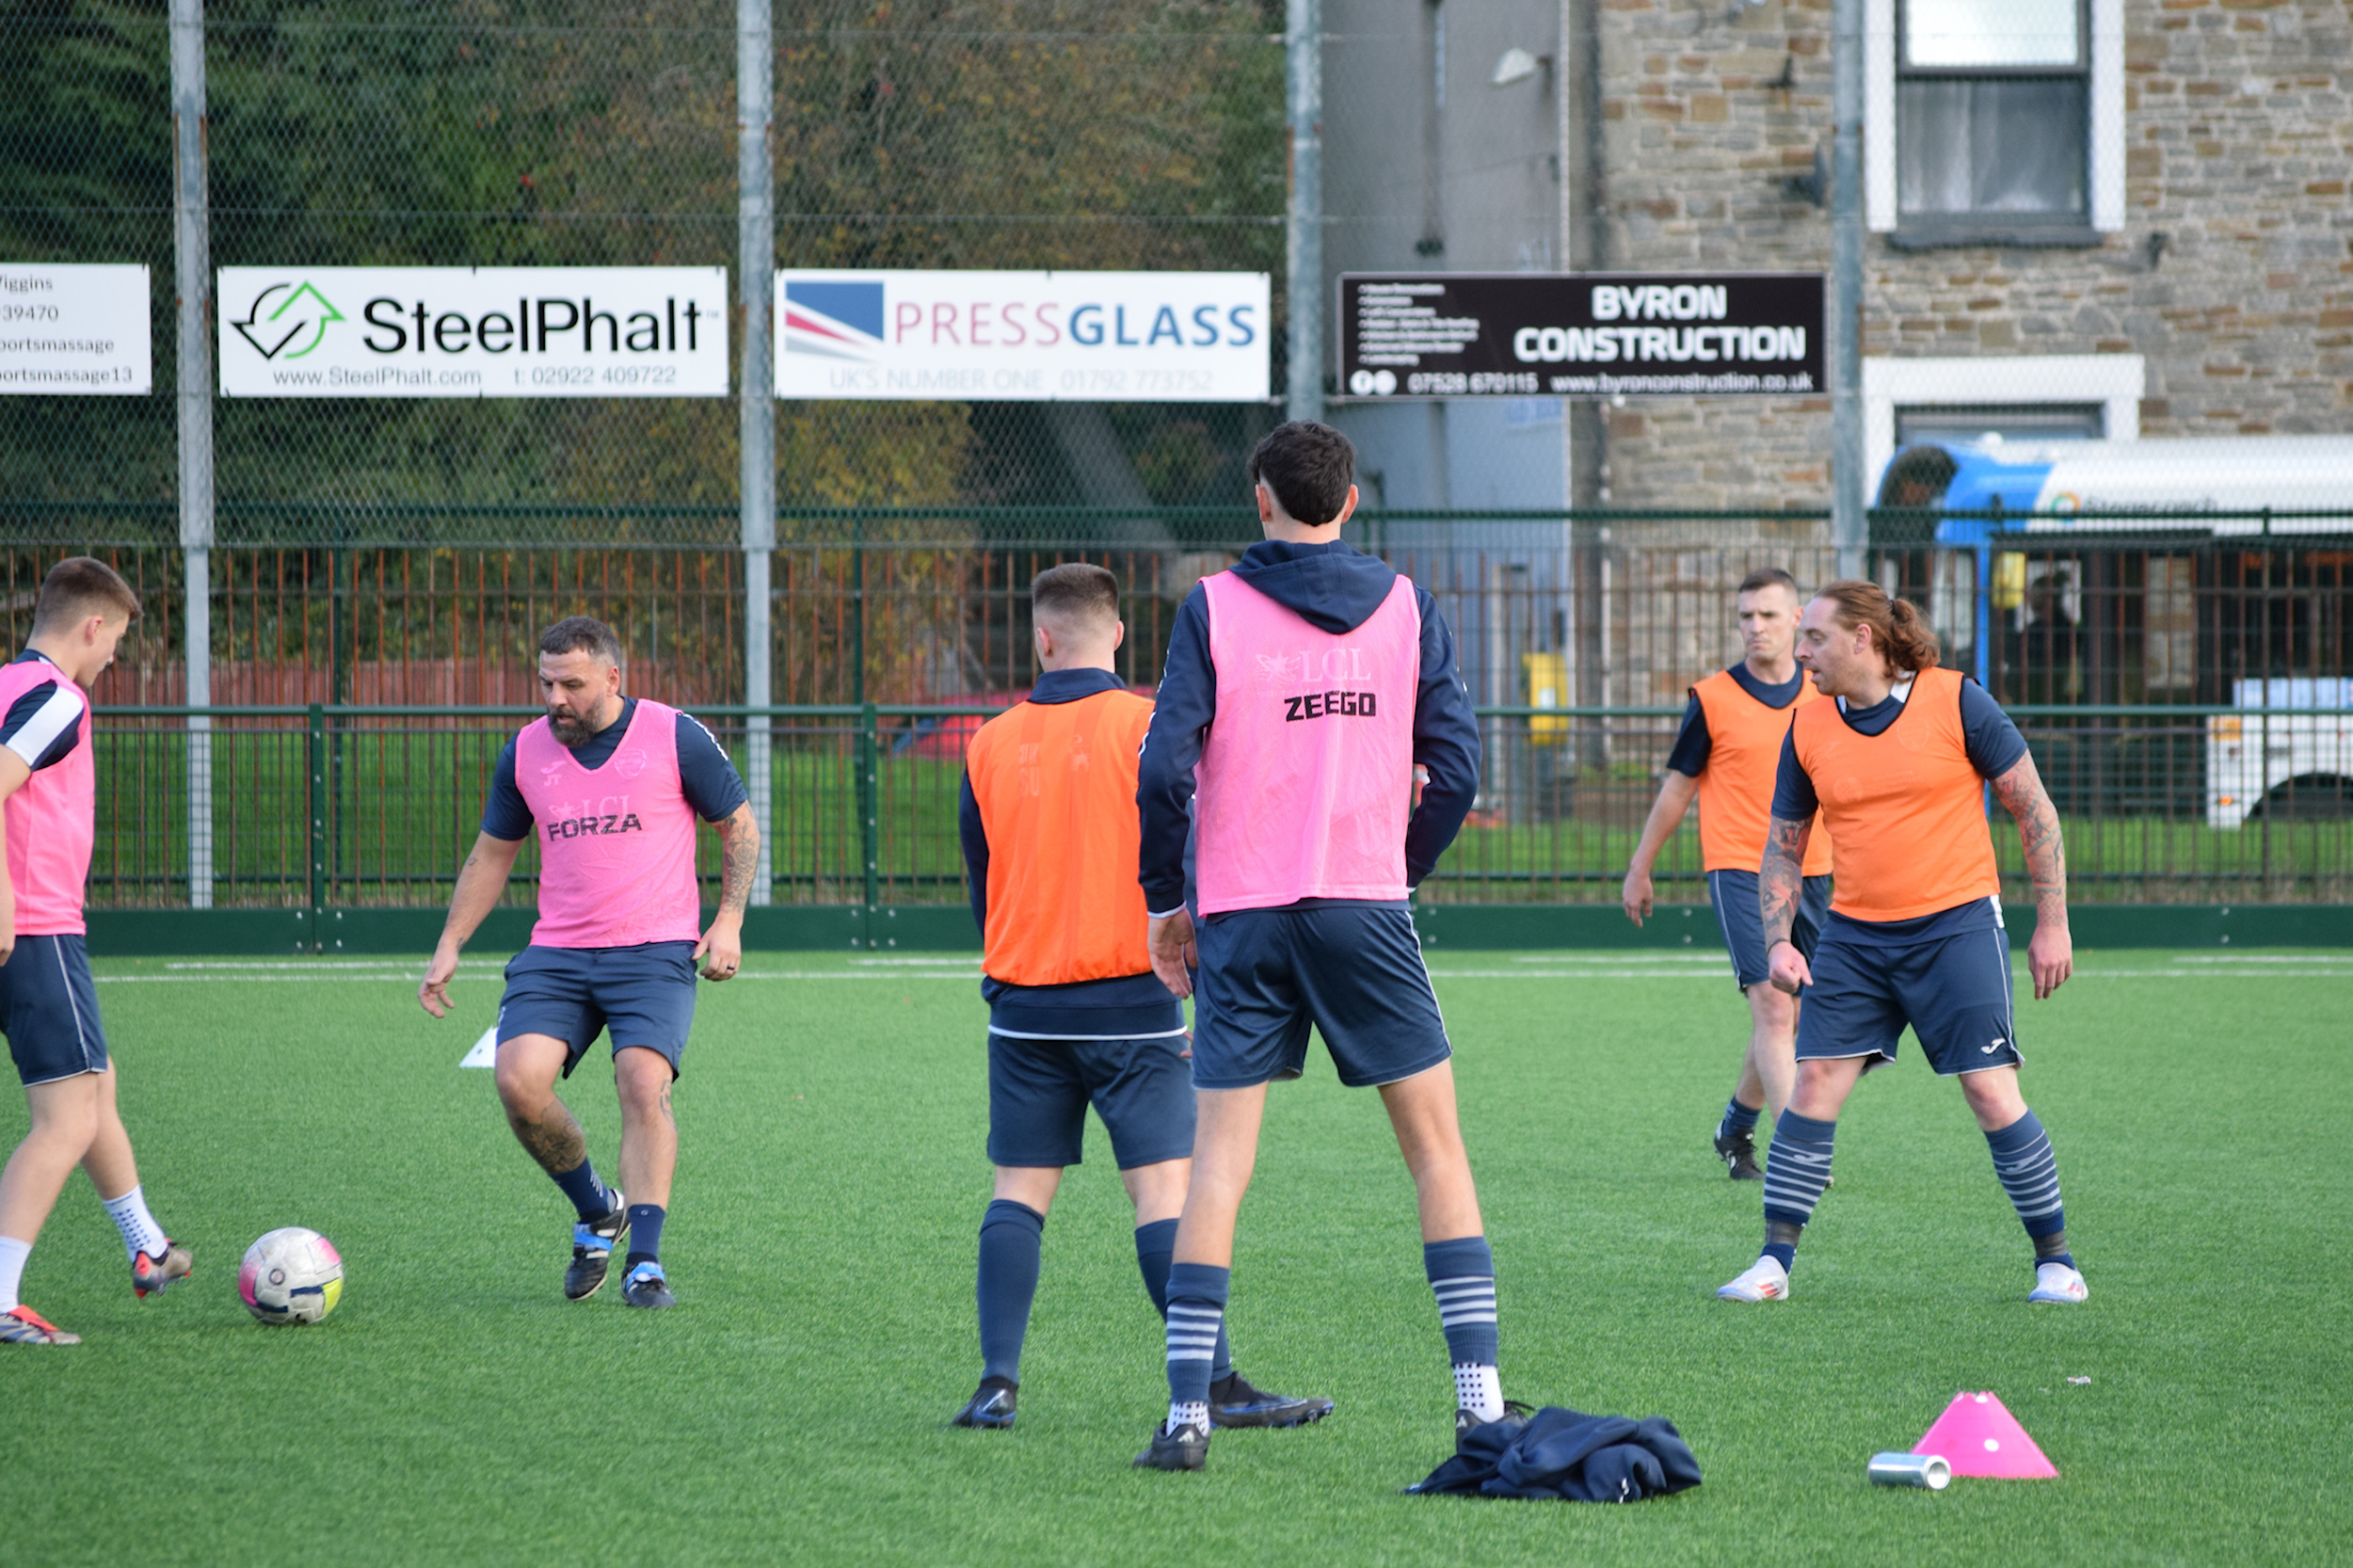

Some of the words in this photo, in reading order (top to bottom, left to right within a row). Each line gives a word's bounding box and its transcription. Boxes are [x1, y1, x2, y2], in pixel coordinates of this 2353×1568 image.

[0, 274, 53, 294] iggins
[1592, 284, 1727, 321] BYRON
[362, 296, 701, 354] SteelPhalt
[895, 301, 1256, 347] PRESSGLASS
[1513, 326, 1807, 363] CONSTRUCTION
[0, 366, 133, 387] ortsmassage13
[272, 365, 482, 387] www.SteelPhalt.com
[531, 365, 595, 386] 02922
[601, 365, 677, 386] 409722
[829, 367, 879, 392] UK'S
[887, 367, 986, 392] NUMBER
[992, 368, 1045, 392] ONE
[1059, 368, 1128, 392] 01792
[1549, 371, 1814, 395] www.byronconstruction.co.uk
[1299, 648, 1372, 684] LCL
[1284, 690, 1377, 723] ZEEGO
[547, 813, 643, 842] FORZA
